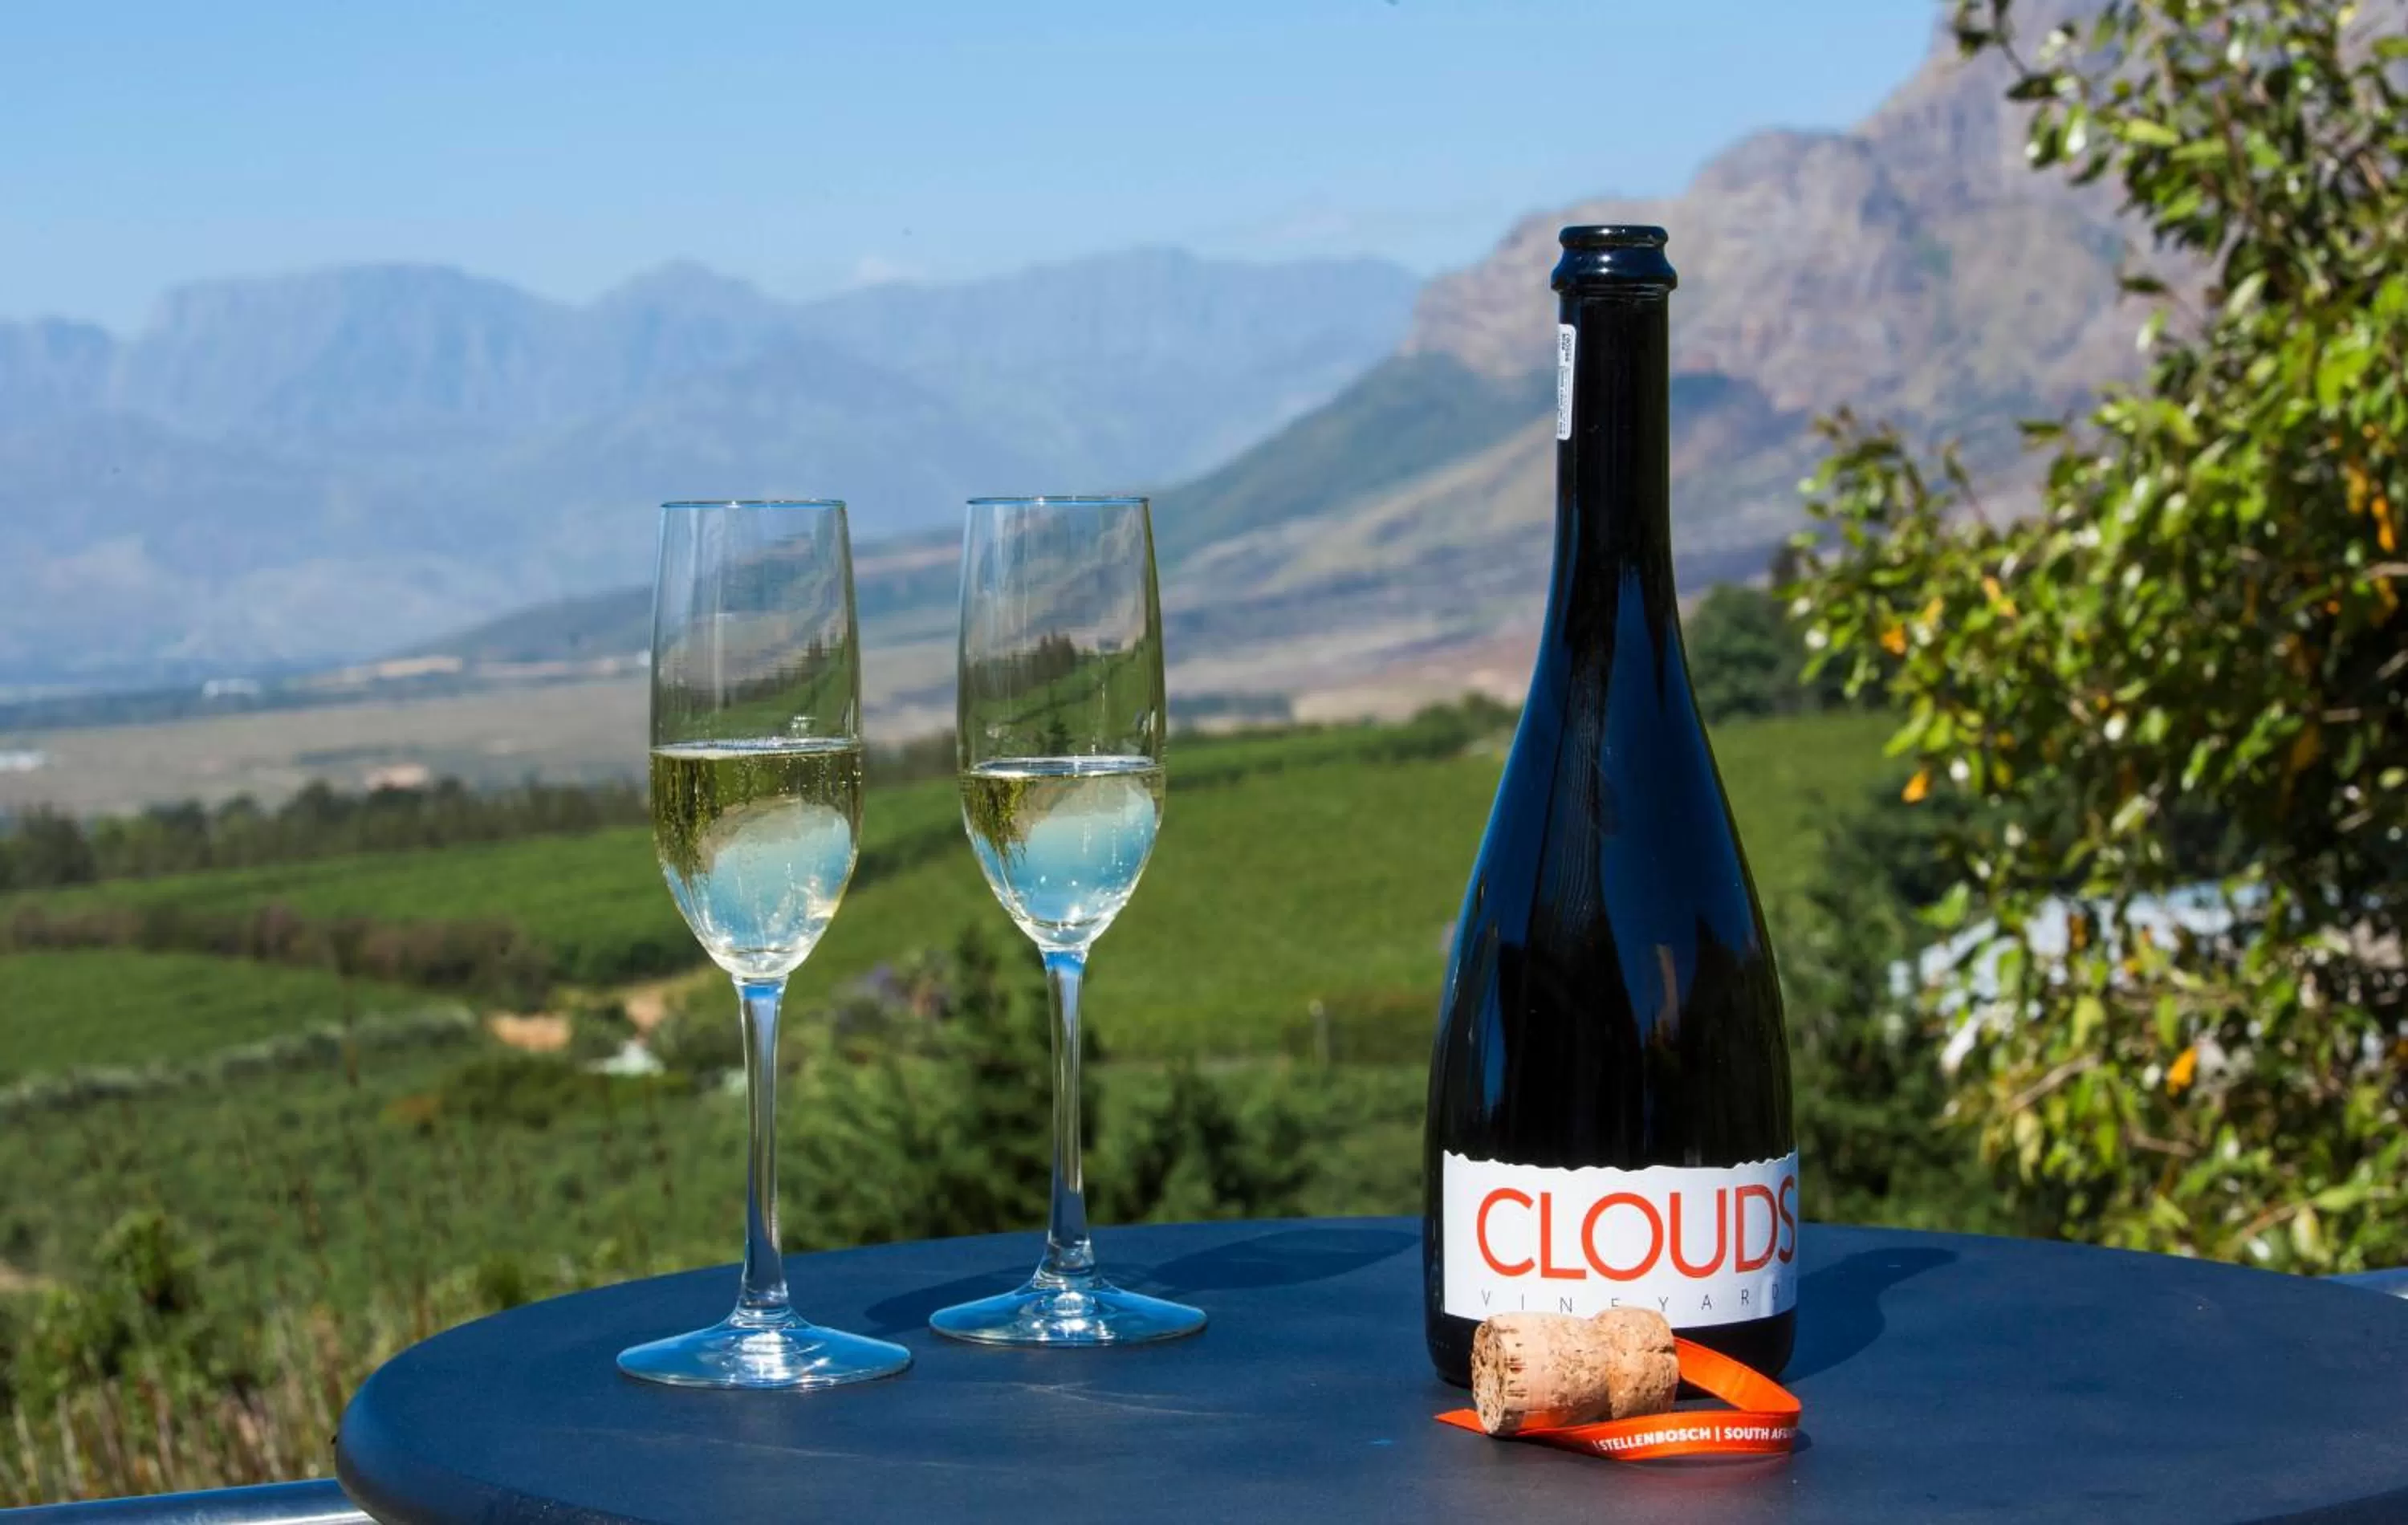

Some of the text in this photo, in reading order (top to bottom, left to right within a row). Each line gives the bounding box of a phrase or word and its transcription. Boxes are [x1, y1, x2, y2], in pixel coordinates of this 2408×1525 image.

[1476, 1174, 1796, 1282] CLOUDS
[1599, 1427, 1711, 1451] STELLENBOSCH
[1723, 1427, 1770, 1440] SOUTH
